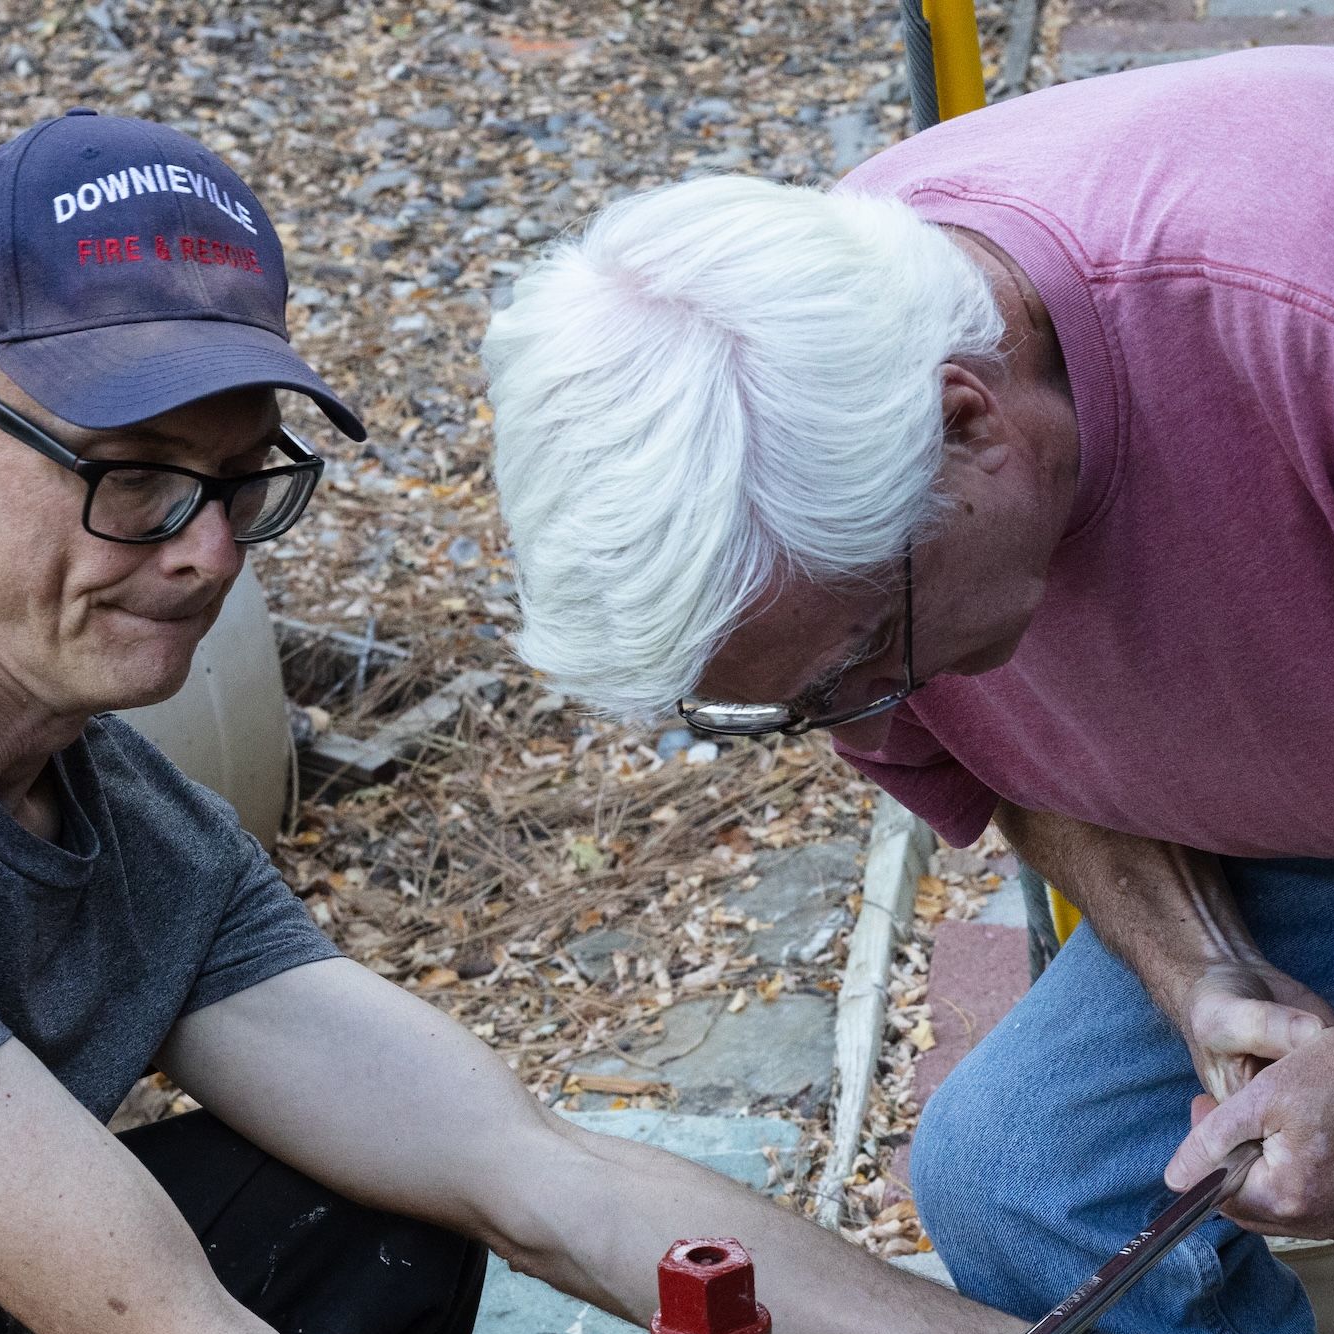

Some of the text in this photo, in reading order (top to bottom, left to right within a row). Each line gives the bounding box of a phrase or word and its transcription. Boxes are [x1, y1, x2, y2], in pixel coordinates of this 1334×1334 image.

[53, 164, 258, 235] DOWNIEVILLE
[77, 235, 264, 274] FIRE & RESCUE
